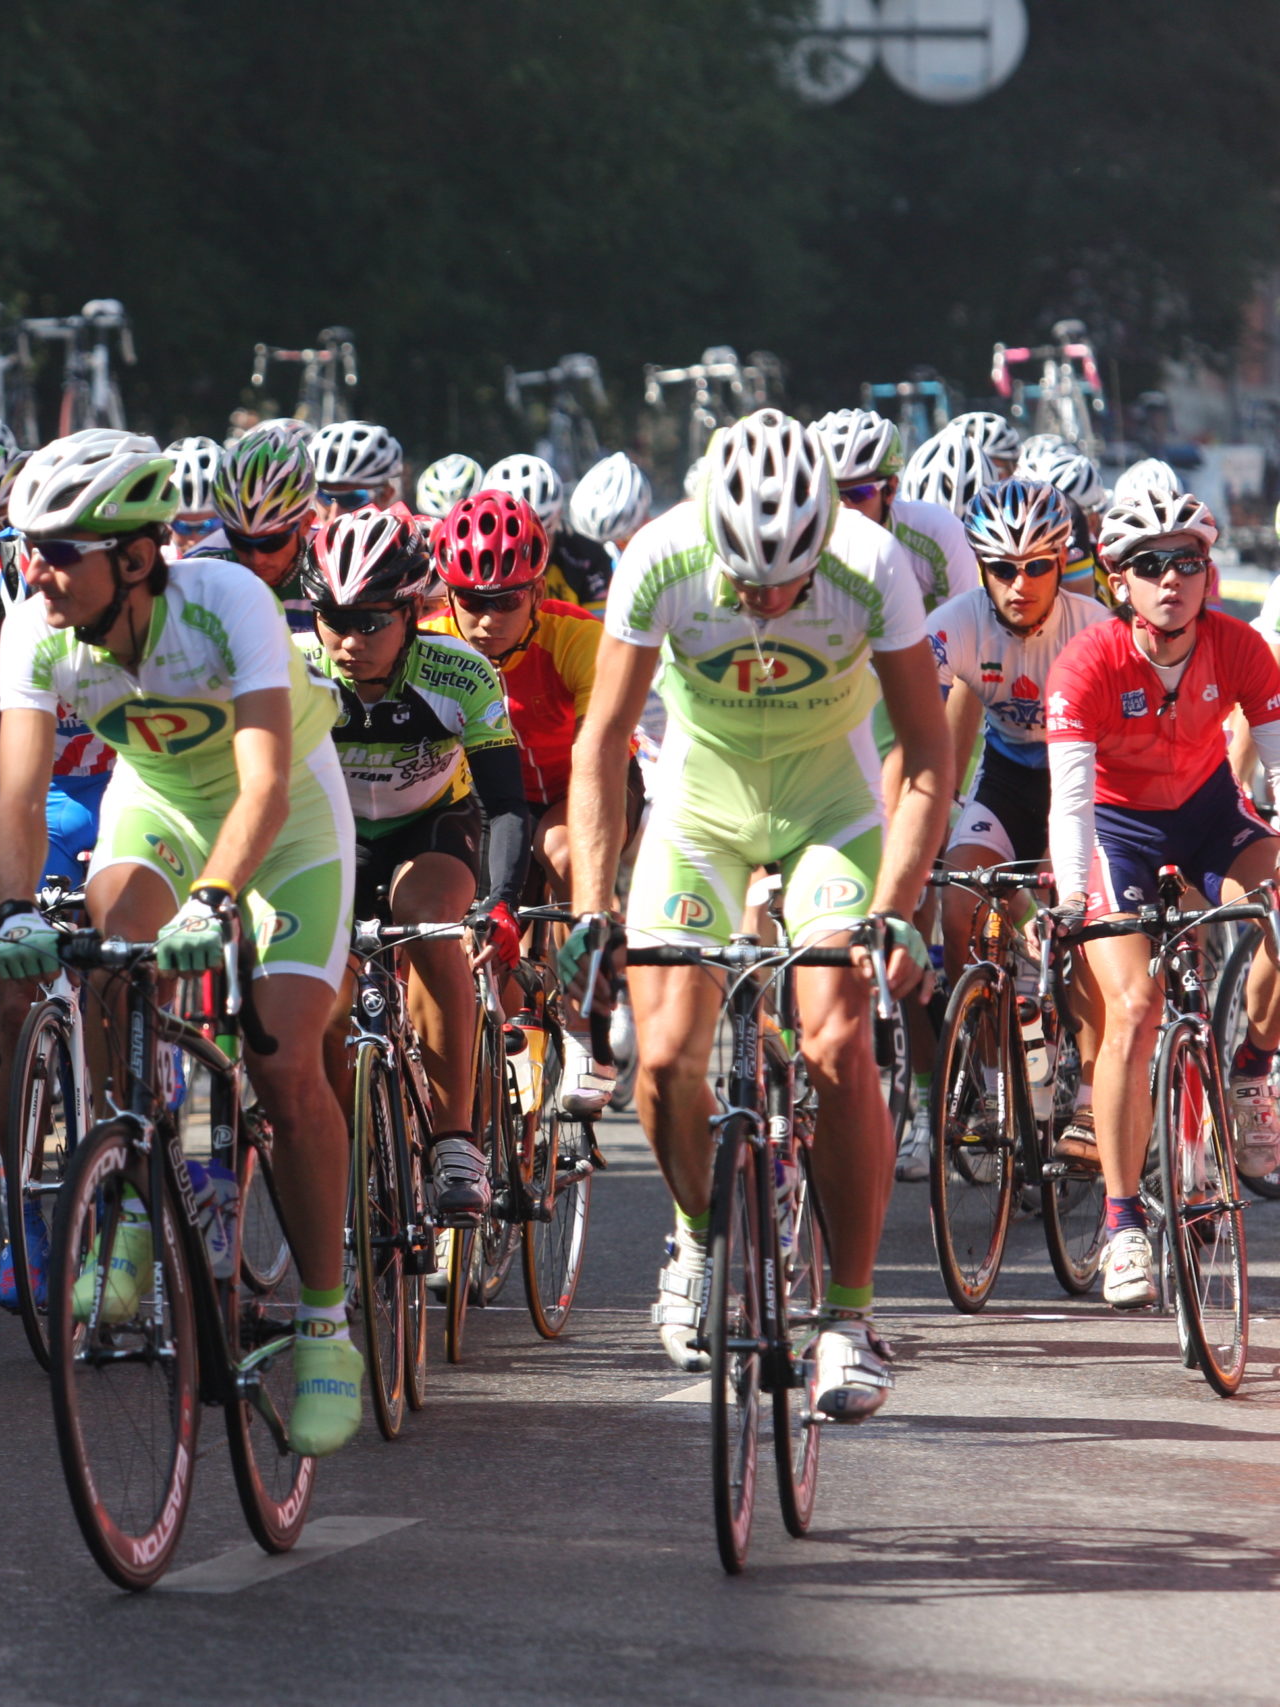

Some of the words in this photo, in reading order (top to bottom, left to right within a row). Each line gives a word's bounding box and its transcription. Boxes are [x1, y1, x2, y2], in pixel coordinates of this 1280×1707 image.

[418, 642, 496, 691] Champion
[349, 771, 393, 783] TEAM
[89, 1264, 105, 1328] EASTON
[154, 1261, 165, 1325] EASTON
[767, 1258, 776, 1320] EASTON
[133, 1442, 188, 1565] EASTON
